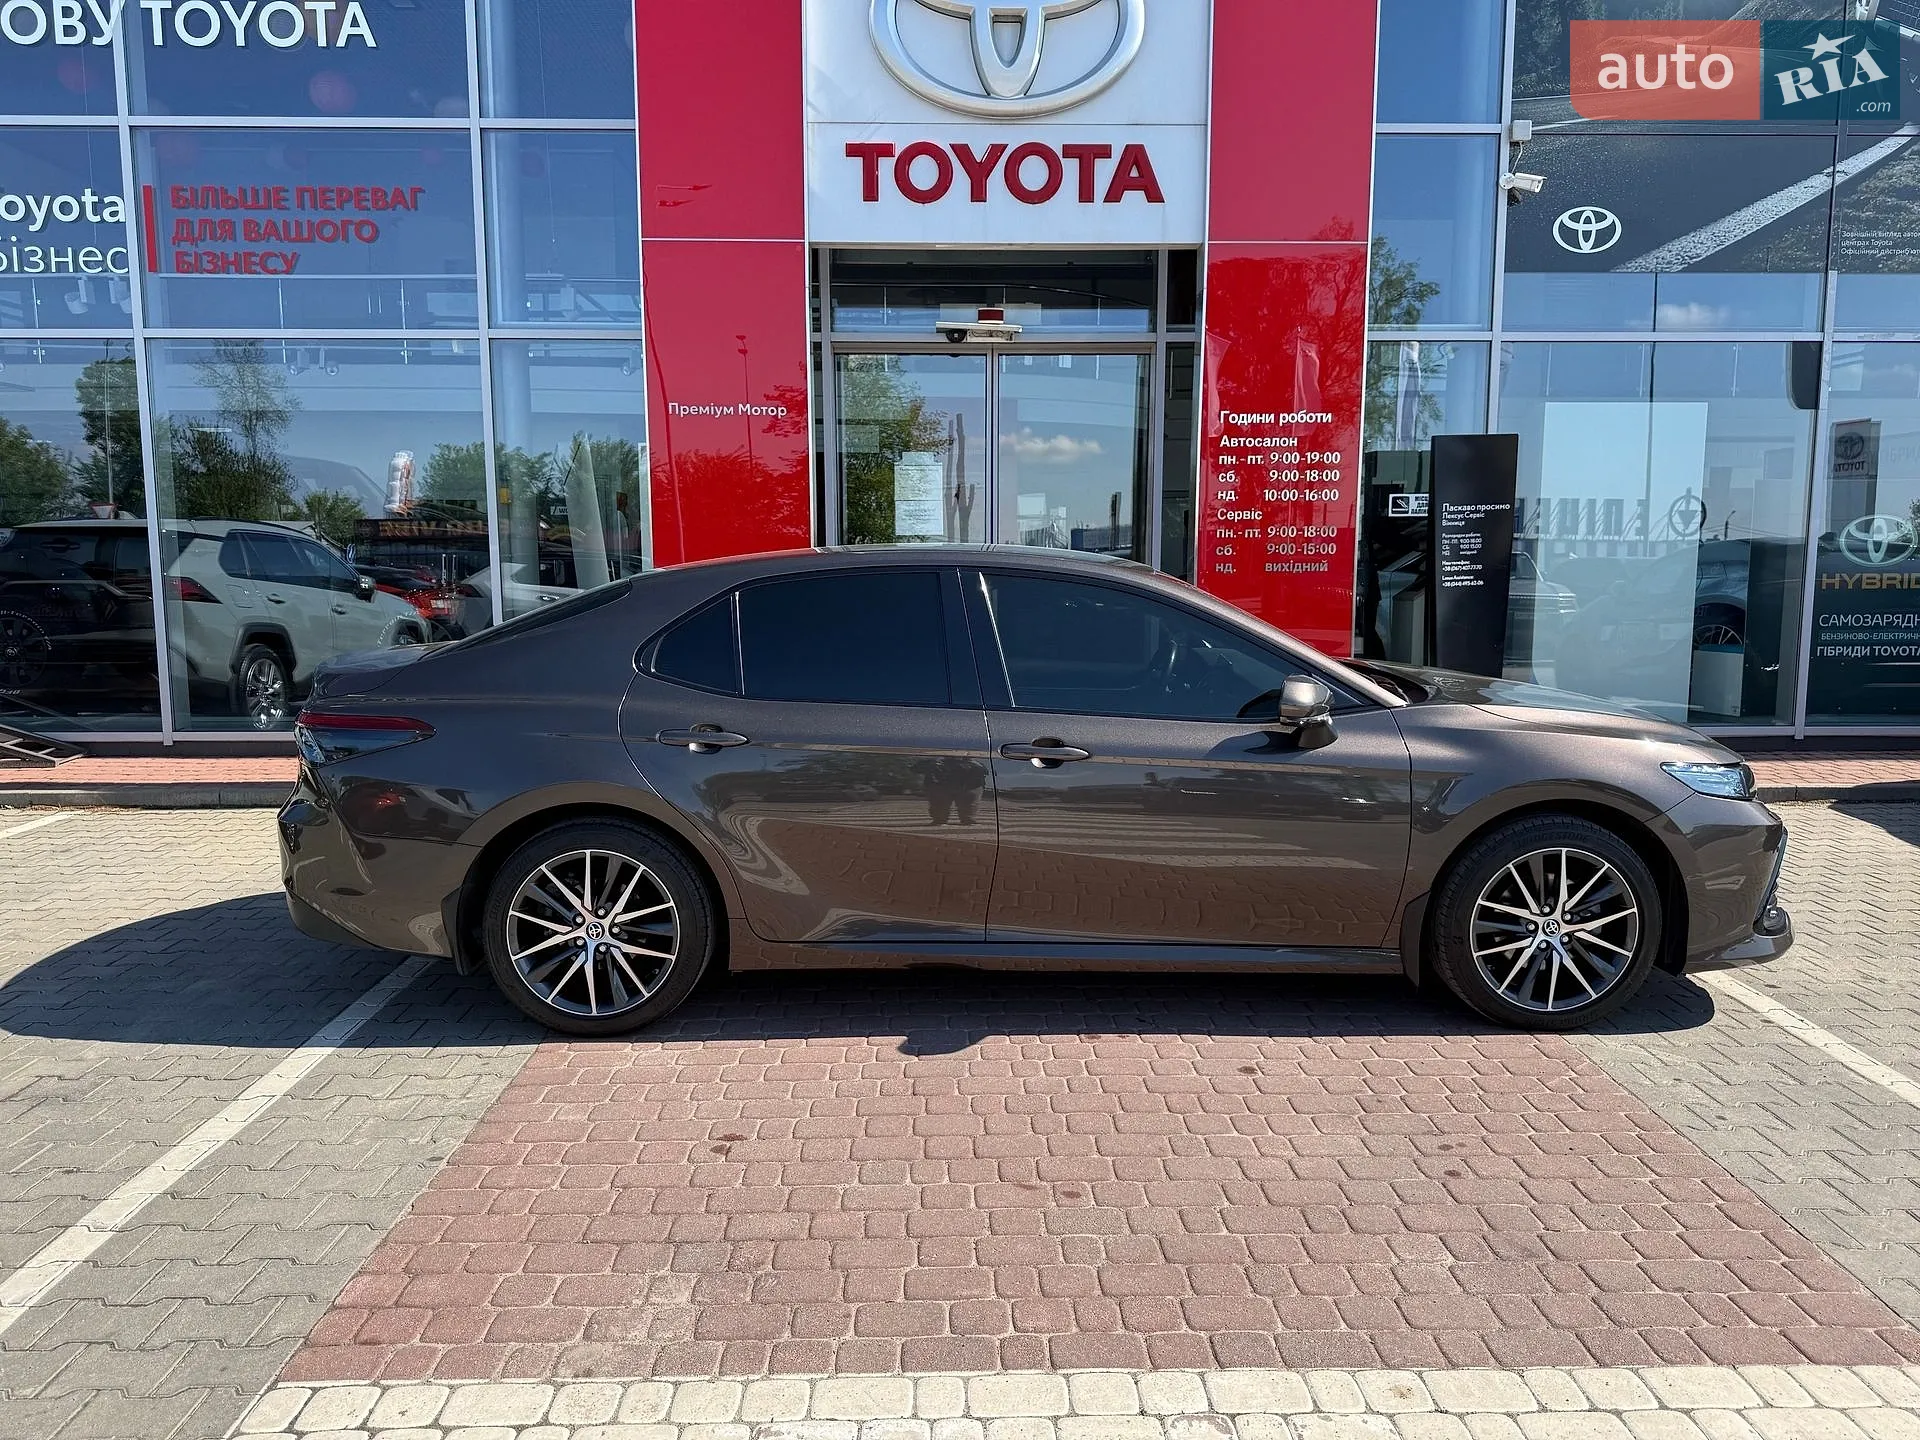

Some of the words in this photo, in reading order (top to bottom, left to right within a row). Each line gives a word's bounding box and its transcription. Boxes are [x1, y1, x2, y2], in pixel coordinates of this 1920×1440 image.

[141, 0, 377, 47] TOYOTA
[845, 142, 1165, 204] TOYOTA
[171, 185, 288, 210] БІЛЬШЕ
[296, 186, 426, 211] ПЕРЕВАГ
[172, 219, 236, 245] ДЛЯ
[244, 219, 379, 244] ВАШОГО
[175, 251, 299, 274] БІЗНЕСУ
[668, 402, 734, 418] Преміум
[738, 404, 787, 418] Мотор
[1220, 410, 1274, 426] Години
[1280, 410, 1332, 426] роботи
[1220, 435, 1297, 447] Автосалон
[1270, 452, 1340, 464] 9:00-19:00
[1219, 471, 1238, 482] сб.
[1270, 470, 1340, 481] 9:00-18:00
[1218, 490, 1238, 501] нд.
[1264, 489, 1339, 501] 10:00-16:00
[1218, 508, 1262, 522] Сервіс
[1268, 526, 1337, 537] 9:00-18:00
[1216, 544, 1236, 555] сб.
[1267, 543, 1336, 554] 9:00-15:00
[1216, 564, 1236, 573] нд.
[1265, 560, 1328, 573] вихідний
[1817, 646, 1870, 658] ГІБРИДИ
